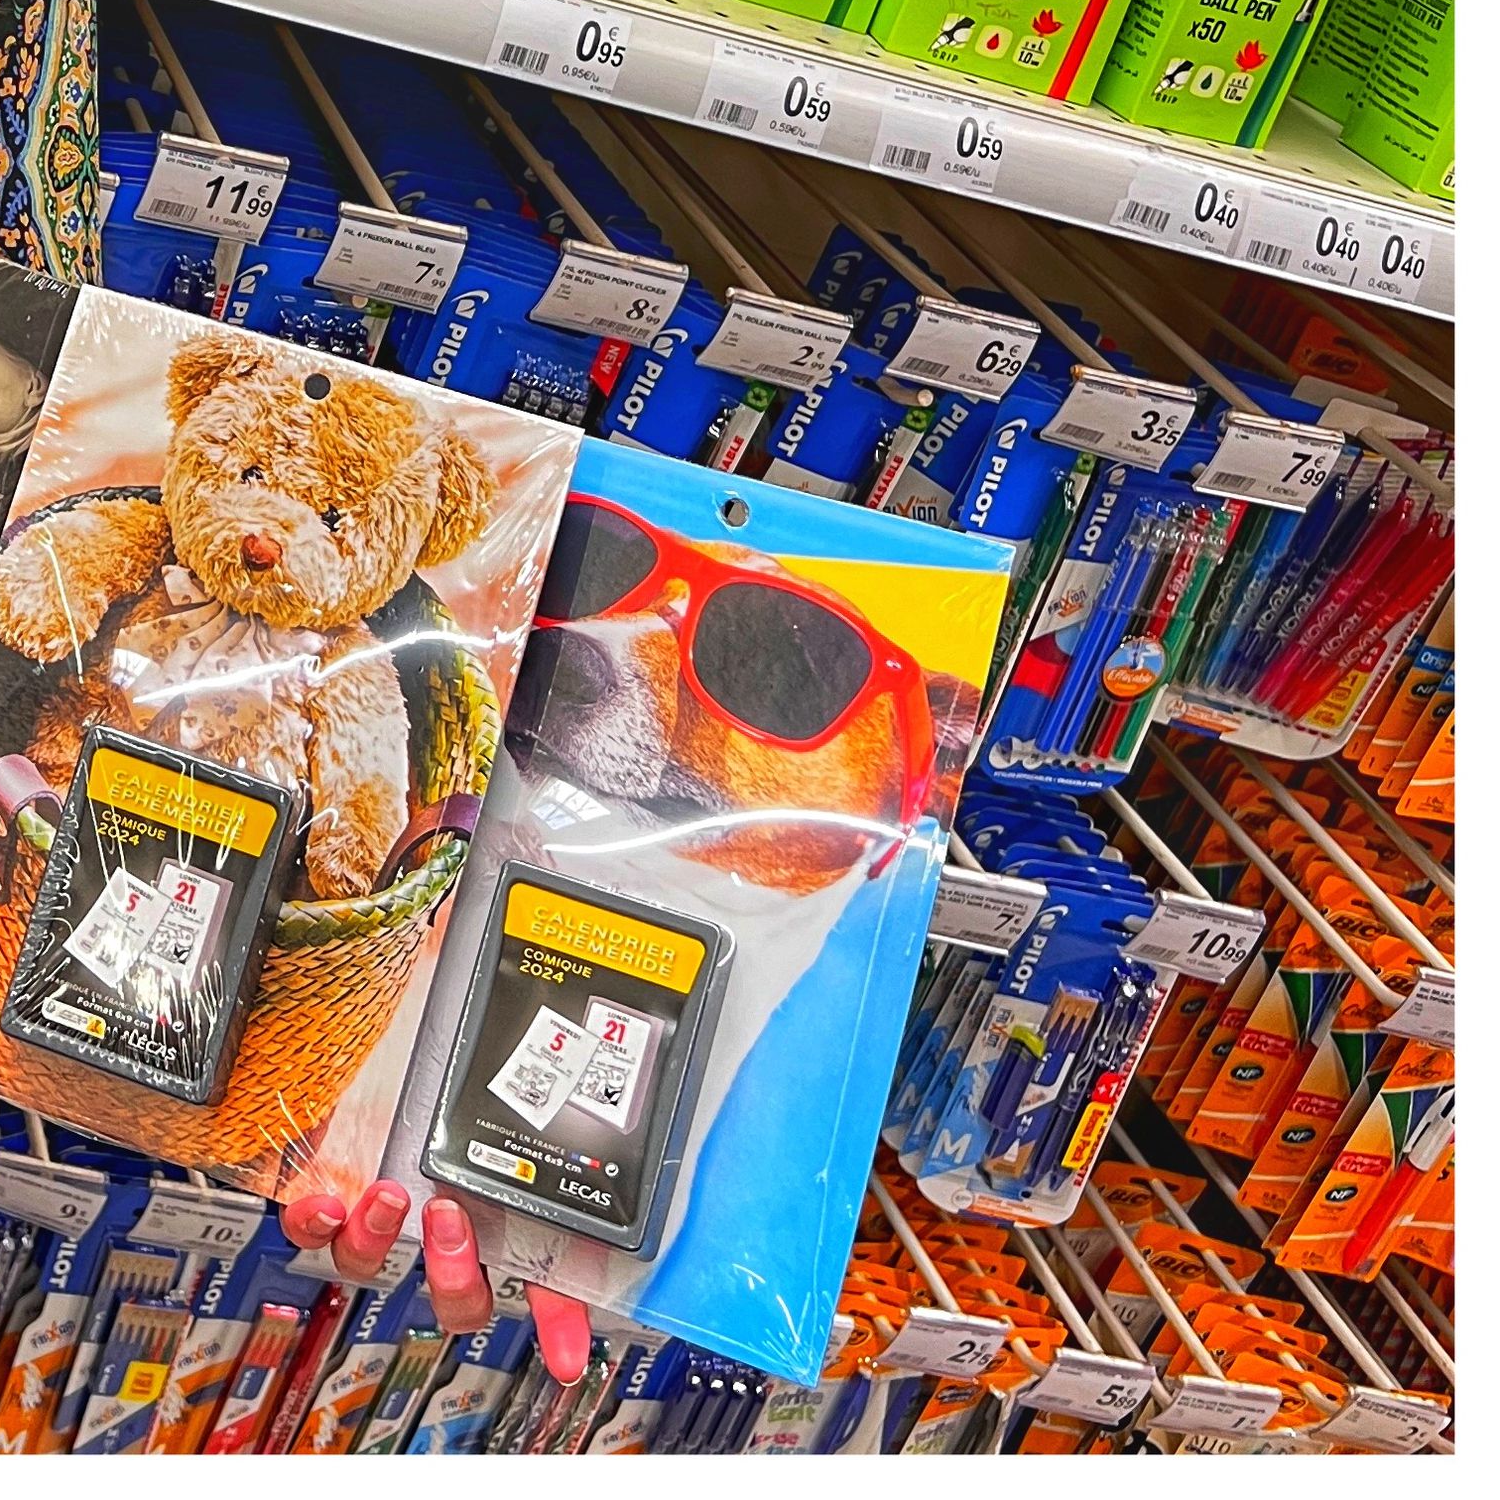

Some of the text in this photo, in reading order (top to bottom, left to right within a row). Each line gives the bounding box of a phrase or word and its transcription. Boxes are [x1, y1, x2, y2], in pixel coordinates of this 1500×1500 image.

[777, 391, 823, 456] PILOT
[916, 403, 969, 468] PILOT
[969, 456, 1008, 527] PILOT
[1080, 492, 1117, 555] PILOT
[112, 769, 247, 824] CALENDRIER
[97, 822, 139, 846] 2024
[101, 810, 167, 841] COMIQUE
[125, 894, 139, 913] 5
[176, 881, 195, 904] 21
[534, 904, 676, 961] CALENDRIER
[519, 959, 564, 984] 2024
[523, 947, 593, 978] COMIQUE
[76, 995, 113, 1018] Format
[134, 1018, 150, 1030] cm
[127, 1031, 178, 1061] LECAS
[549, 1031, 564, 1052] 5
[601, 1019, 626, 1044] 21
[504, 1139, 544, 1162] Format
[564, 1162, 582, 1175] cm
[937, 1133, 970, 1161] M
[558, 1177, 612, 1207] LECAS
